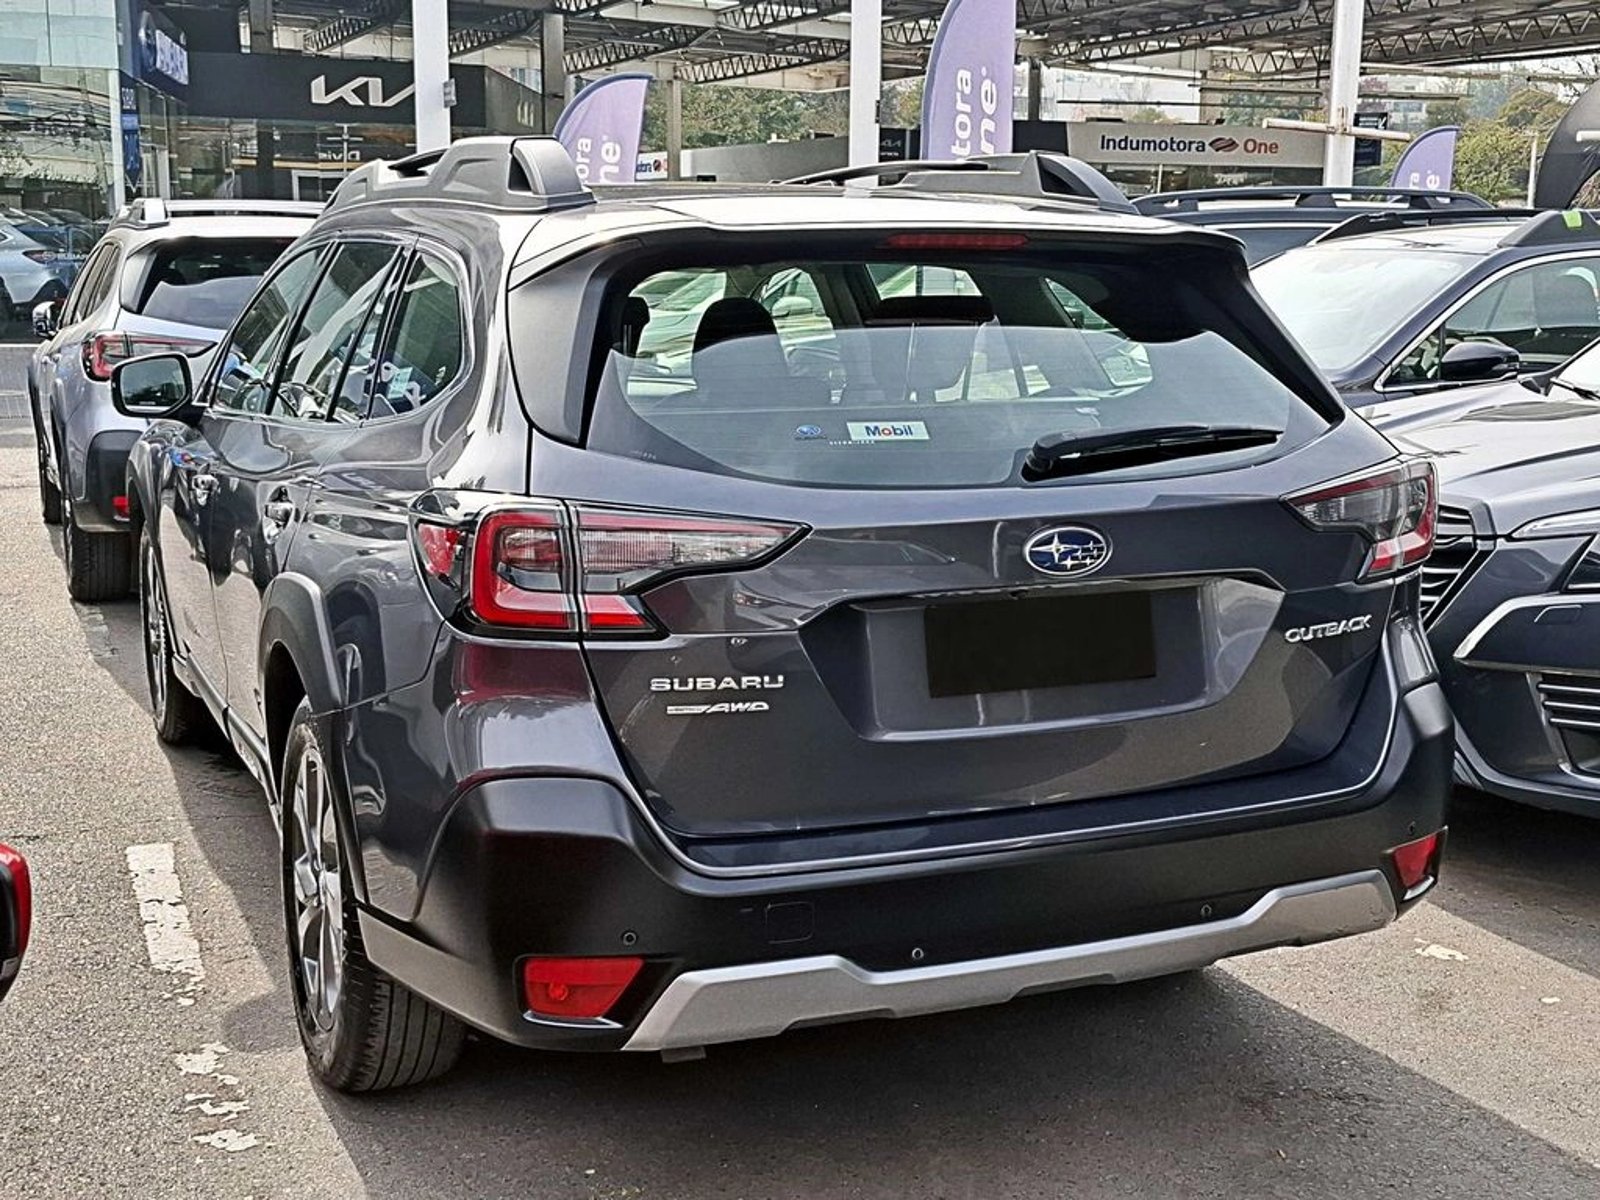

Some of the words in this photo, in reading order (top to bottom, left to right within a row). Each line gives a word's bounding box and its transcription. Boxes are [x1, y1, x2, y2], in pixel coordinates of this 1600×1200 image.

[1100, 135, 1206, 152] Indumotora
[1243, 138, 1279, 154] One
[865, 424, 914, 437] Mobil
[1284, 614, 1373, 643] OUTBACK
[650, 674, 784, 691] SUBARU
[705, 701, 770, 714] AWD
